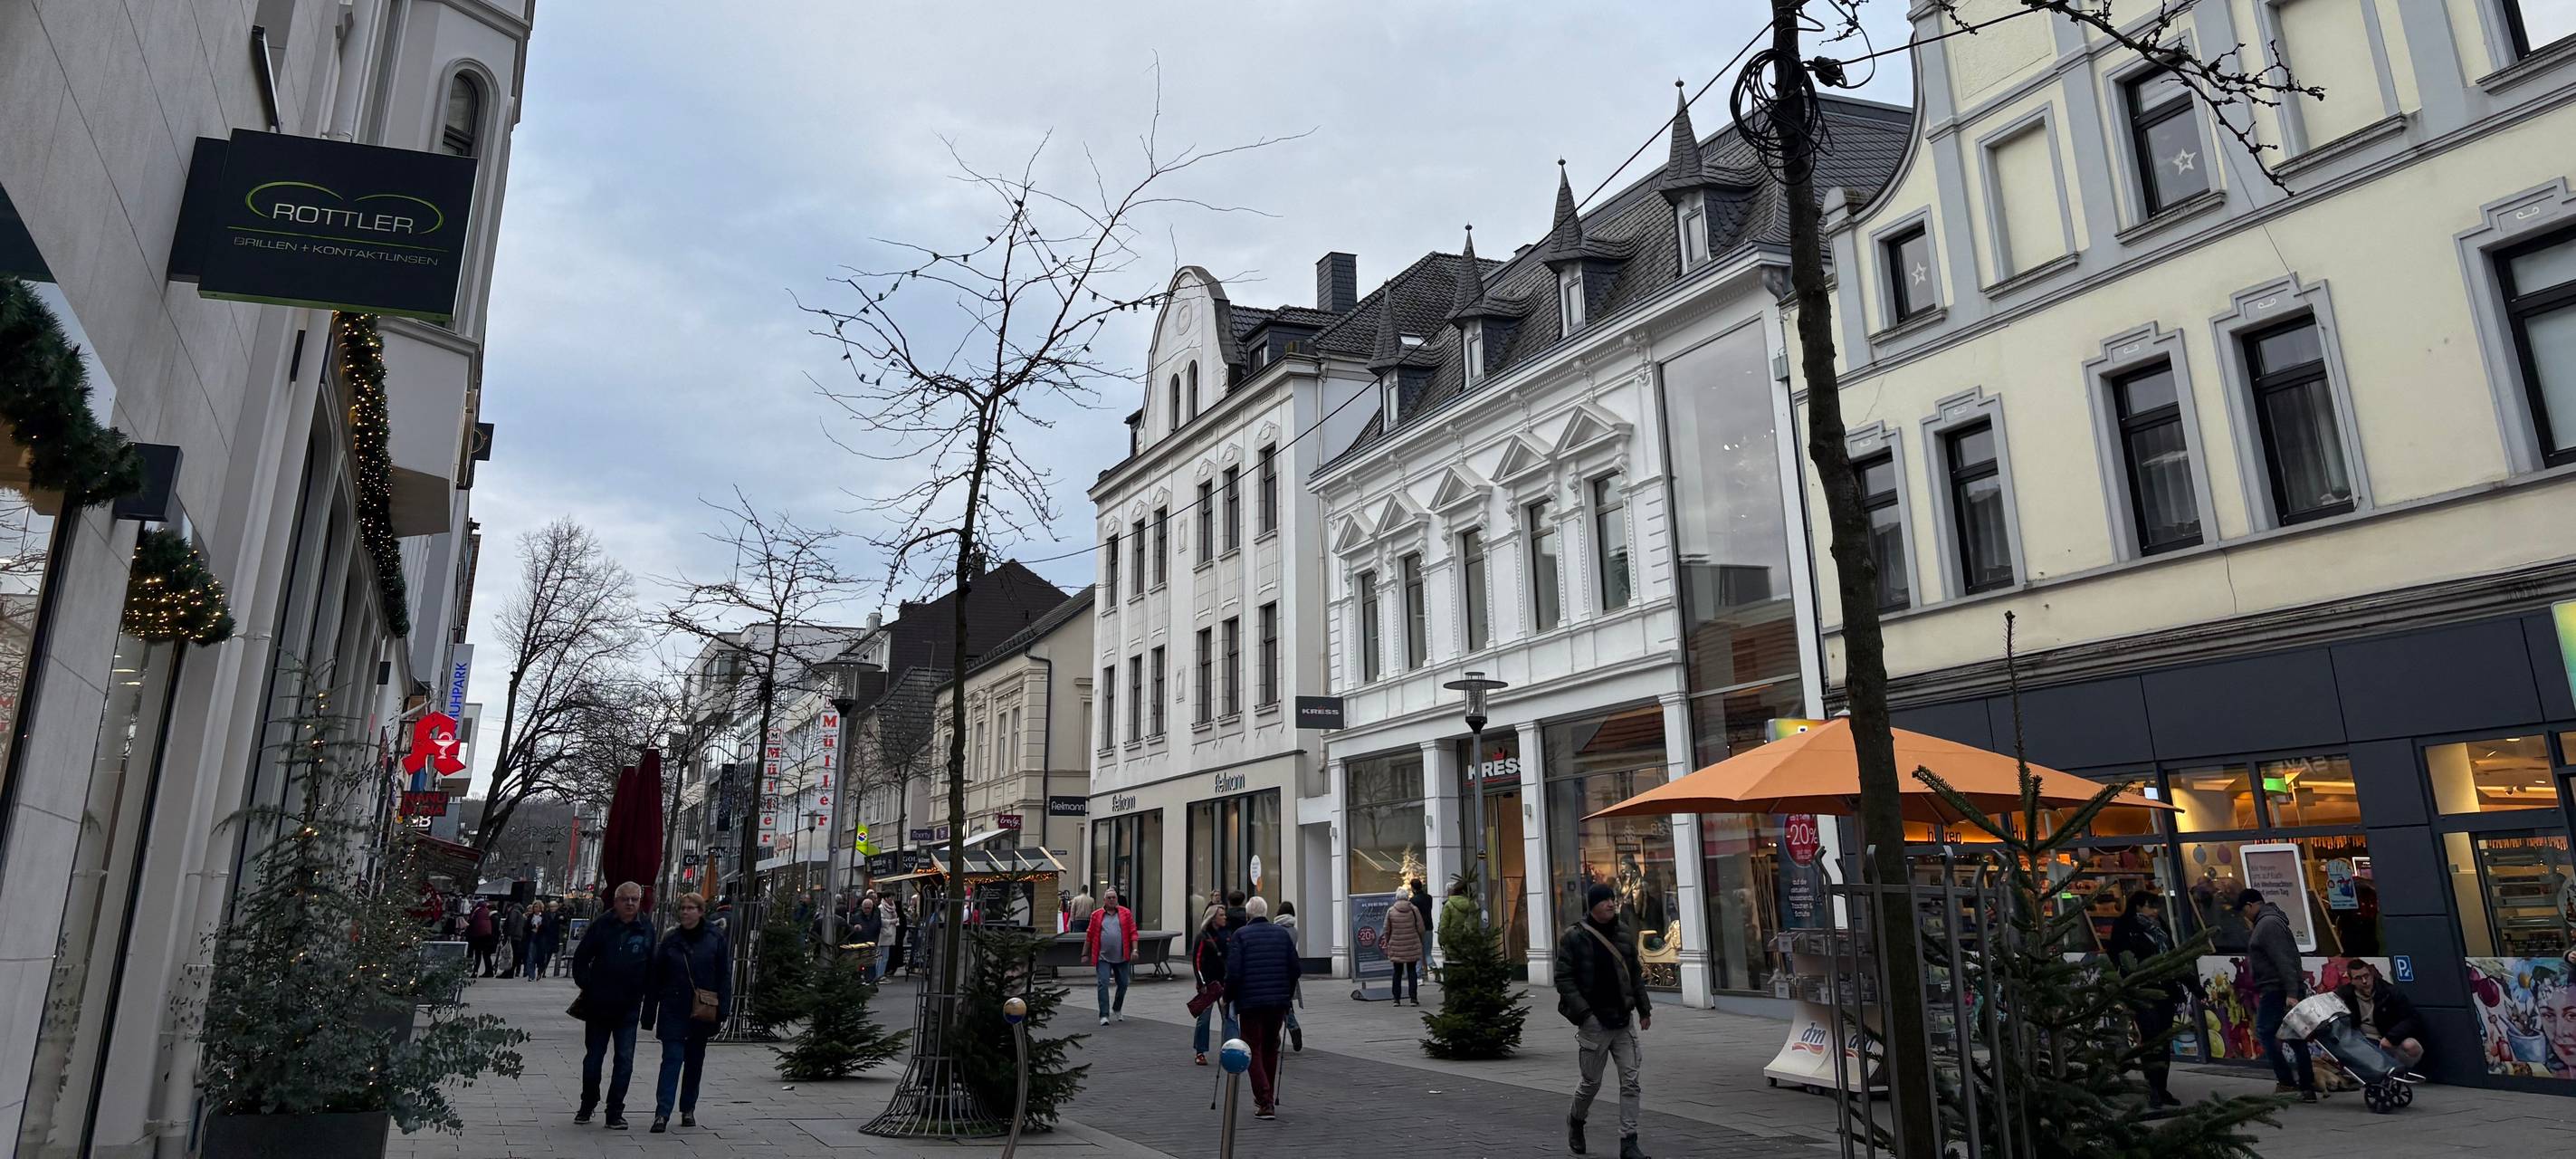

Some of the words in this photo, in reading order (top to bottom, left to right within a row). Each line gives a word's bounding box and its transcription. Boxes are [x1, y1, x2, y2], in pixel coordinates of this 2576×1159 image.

[272, 203, 414, 235] ROTTLER
[234, 236, 298, 254] BRILLEN
[301, 244, 310, 253] +
[312, 244, 439, 267] KONTAKTLINSEN
[817, 715, 838, 826] Müller
[1786, 823, 1818, 846] -20%
[1801, 1021, 1827, 1044] dm
